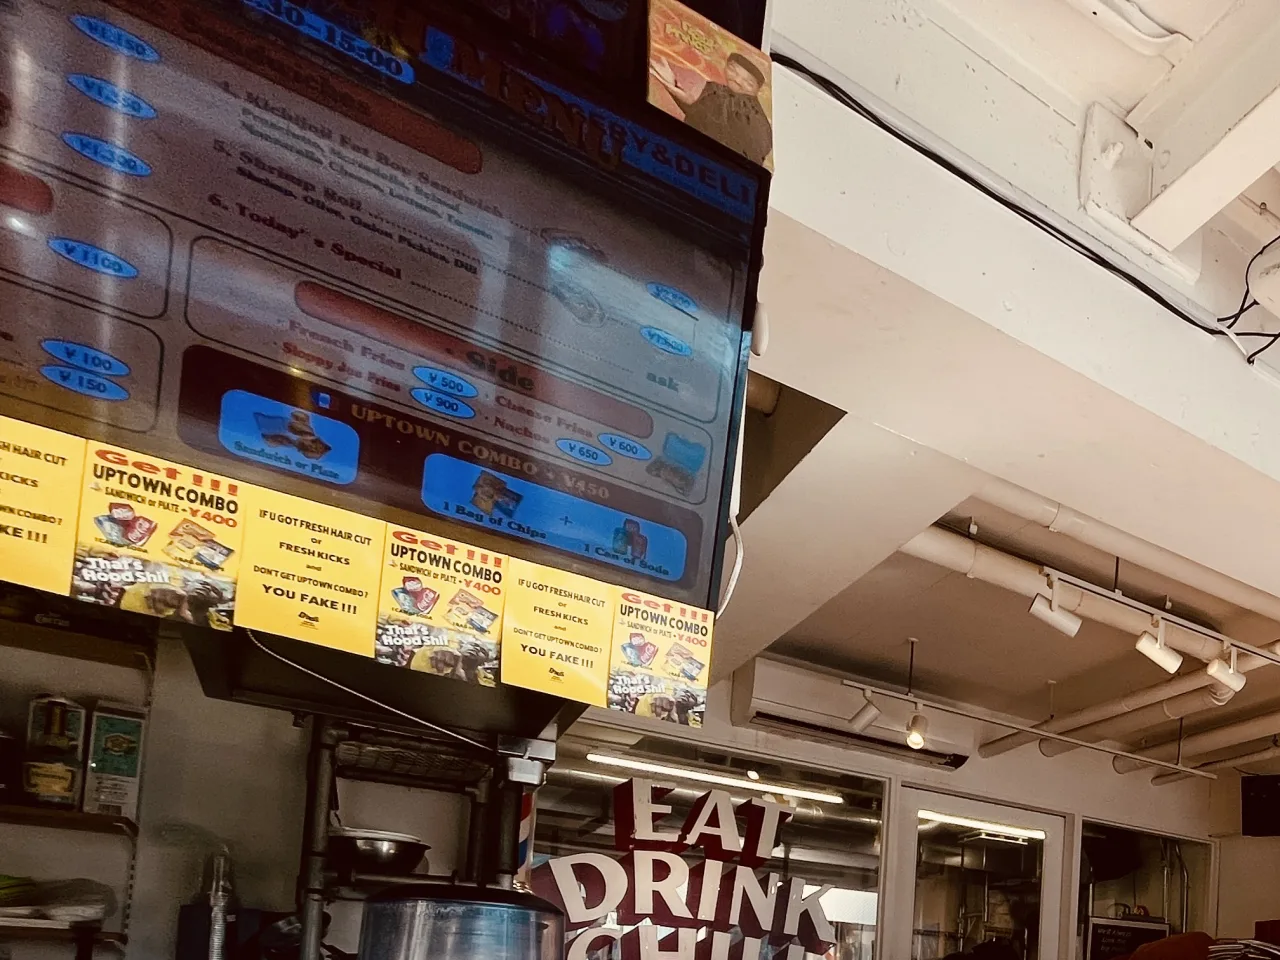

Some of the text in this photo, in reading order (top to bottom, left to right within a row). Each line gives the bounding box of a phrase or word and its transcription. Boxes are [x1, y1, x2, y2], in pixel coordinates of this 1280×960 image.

[239, 151, 317, 194] Shrimp
[331, 241, 402, 280] Special
[289, 319, 406, 371] French Fries
[282, 339, 334, 370] Sloppy
[367, 370, 402, 392] Fries
[646, 371, 679, 392] ask
[493, 416, 552, 444] Nachos
[496, 394, 594, 439] Cheese Fries
[234, 440, 292, 465] Sandwich
[350, 402, 451, 447] UPTOWN
[457, 439, 539, 477] COMBO
[13, 445, 69, 467] HAIR CUT
[94, 449, 184, 482] Get
[92, 462, 240, 516] UPTOWN COMBO
[105, 486, 148, 506] SANDWICH
[188, 507, 239, 528] ¥400
[455, 504, 548, 541] Bag of Chips
[277, 514, 299, 527] GOT
[299, 519, 330, 535] FRESH
[331, 527, 354, 542] HAIR
[354, 534, 373, 547] CUT
[392, 530, 459, 556] Get
[86, 557, 144, 572] That's
[278, 541, 351, 566] FRESH KICKS
[391, 542, 503, 584] UPTOWN COMBO
[594, 546, 622, 563] Can
[639, 557, 671, 577] Soda
[253, 564, 279, 577] DON'T
[280, 571, 297, 581] GET
[297, 575, 333, 591] UPTOWN
[399, 562, 432, 578] SANDWICH
[463, 578, 502, 596] ¥400
[262, 583, 296, 600] YOU
[300, 593, 339, 611] FAKE
[532, 582, 549, 593] GOT
[549, 586, 573, 600] FRESH
[573, 592, 591, 605] HAIR
[591, 597, 606, 609] CUT
[621, 592, 674, 614] Get
[383, 624, 429, 636] That's
[533, 605, 589, 626] FRESH KICKS
[619, 603, 709, 638] UPTOWN COMBO
[547, 635, 576, 649] UPTOWN
[626, 620, 708, 648] SANDWICH ¥400
[520, 643, 546, 657] YOU
[549, 651, 579, 666] FAKE
[616, 777, 796, 868] EAT
[549, 850, 837, 946] DRINK
